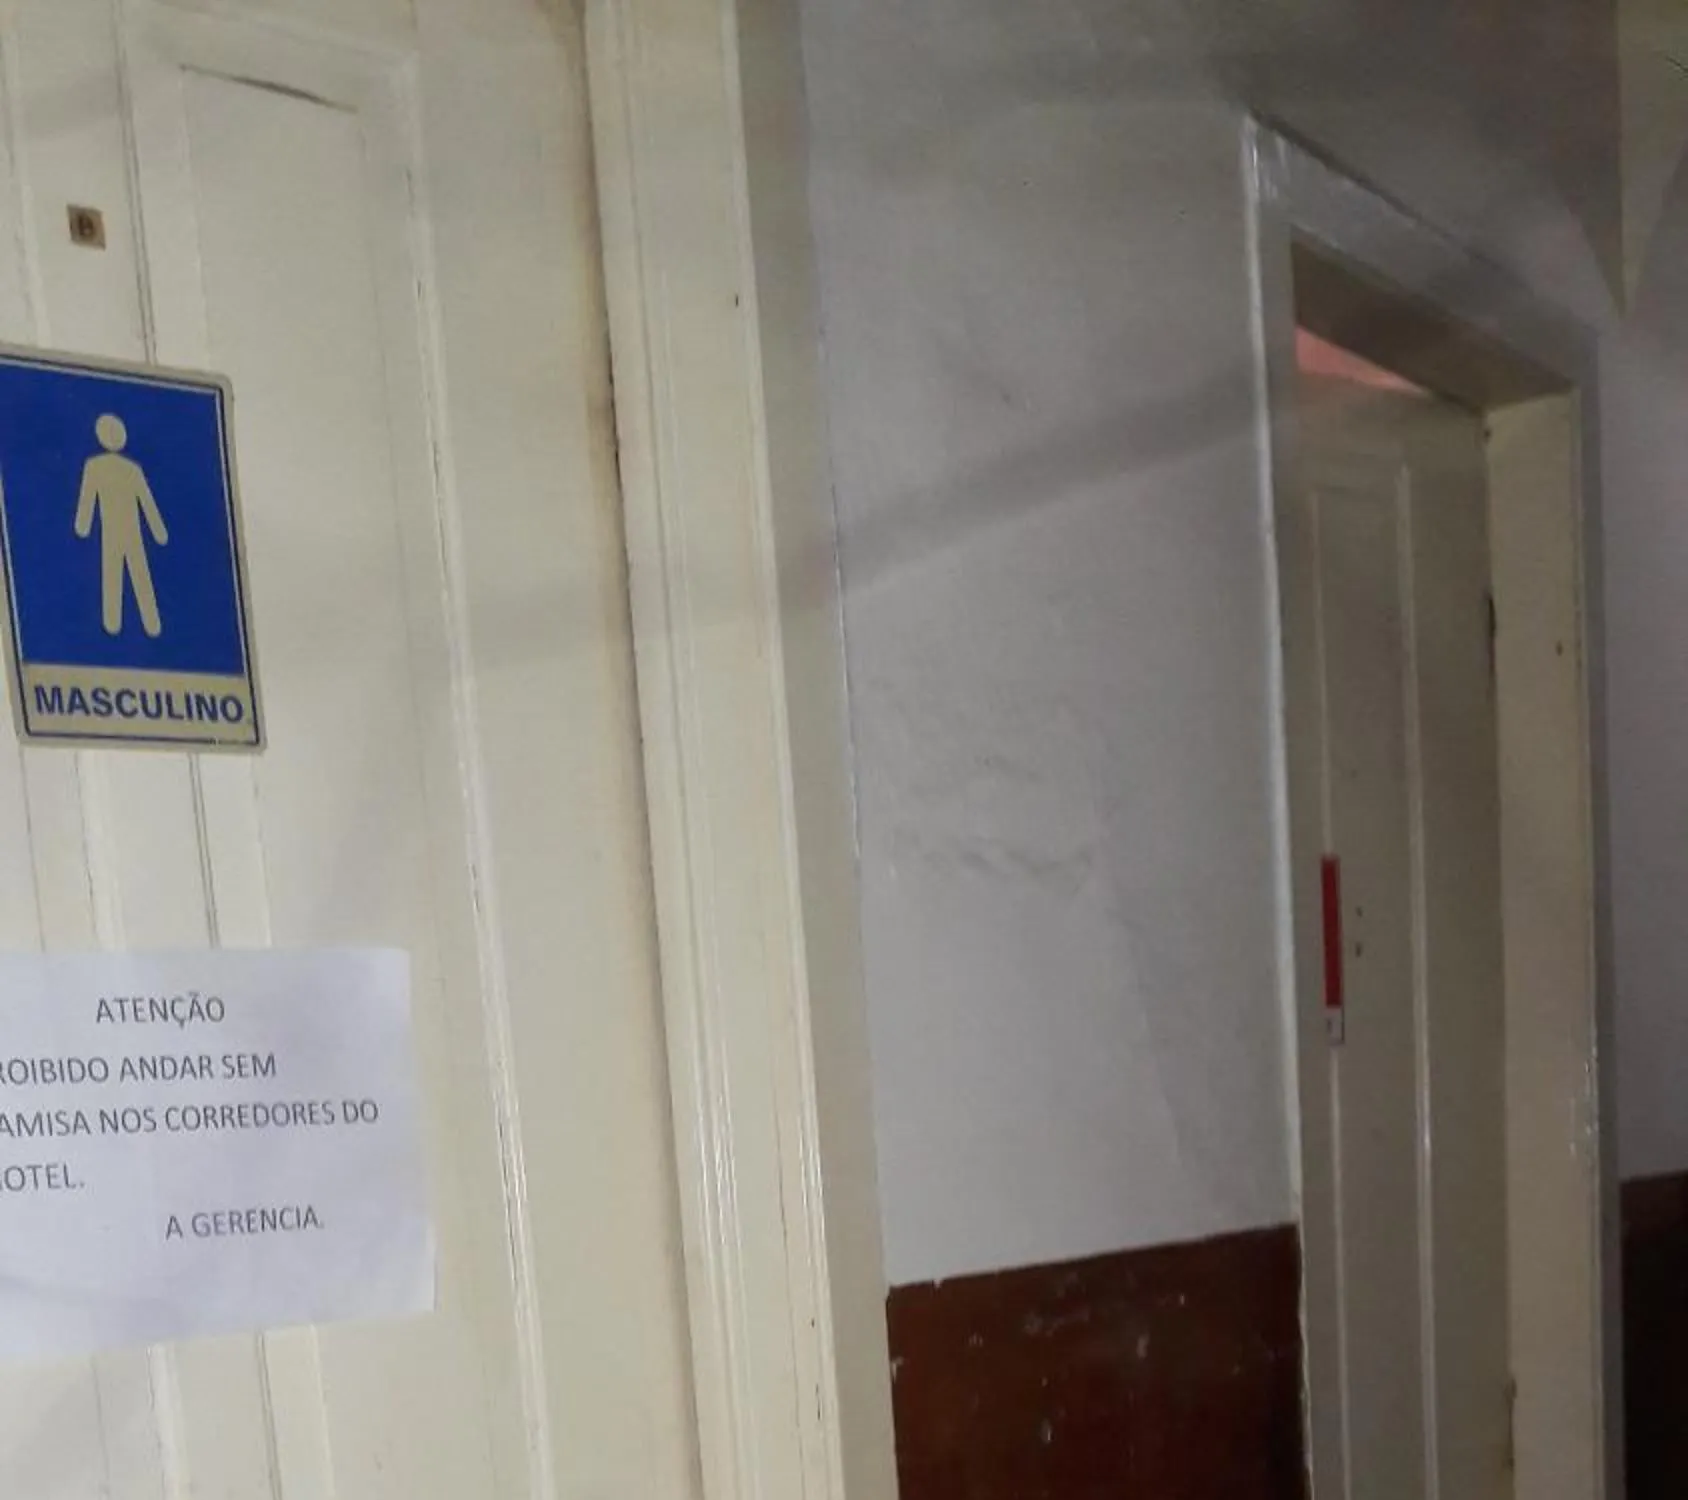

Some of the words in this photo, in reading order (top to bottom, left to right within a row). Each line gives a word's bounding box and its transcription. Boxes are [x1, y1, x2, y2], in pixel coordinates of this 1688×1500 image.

[34, 685, 244, 723] MASCULINO
[95, 991, 226, 1028] ATENÇÃO
[119, 1055, 214, 1082] ANDAR
[221, 1052, 276, 1079] SEM
[100, 1107, 157, 1134] NOS
[165, 1101, 335, 1131] CORREDORES
[343, 1099, 379, 1124] DO
[0, 1163, 85, 1192] OTEL.
[165, 1215, 183, 1240] A
